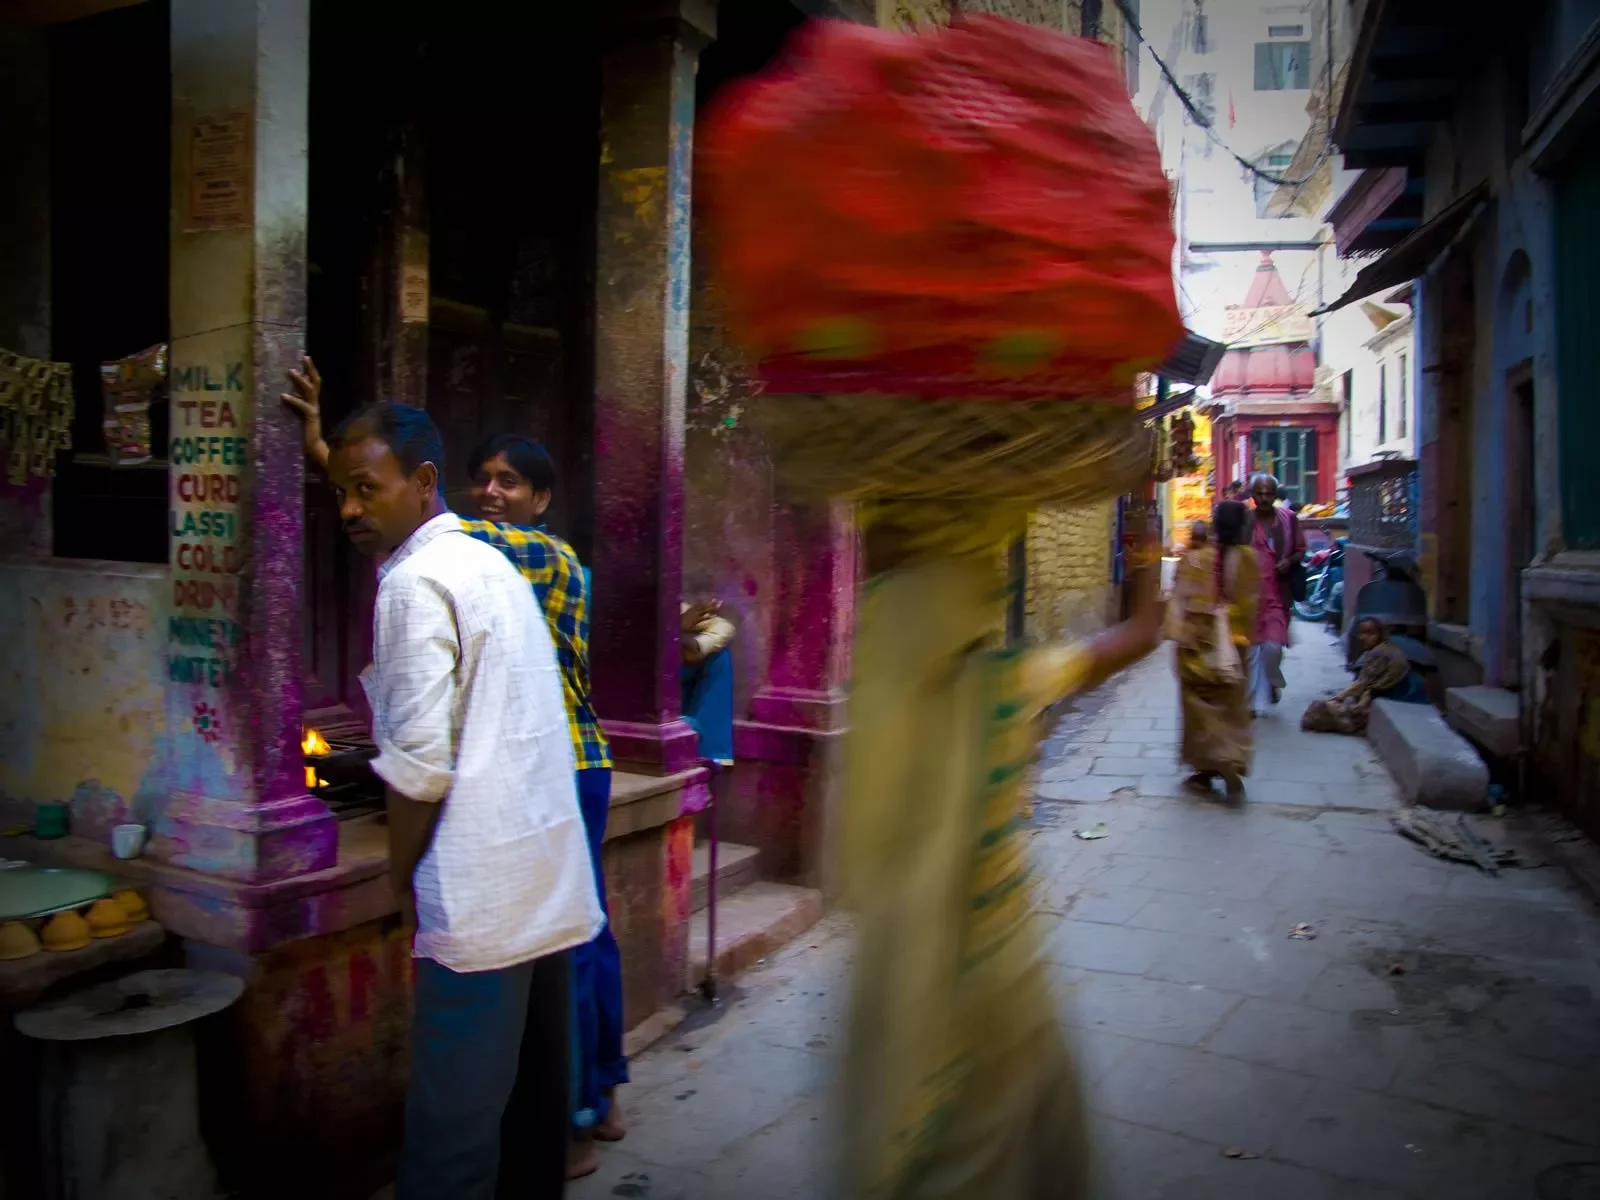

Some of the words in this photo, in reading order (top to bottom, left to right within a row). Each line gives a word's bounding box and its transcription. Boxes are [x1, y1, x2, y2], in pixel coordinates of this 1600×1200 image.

[173, 362, 243, 392] MILK
[177, 400, 238, 428] TEA
[172, 436, 248, 466] COFFEE
[178, 474, 240, 503] CURD
[171, 510, 236, 537] LASSI
[177, 543, 239, 573] COLD
